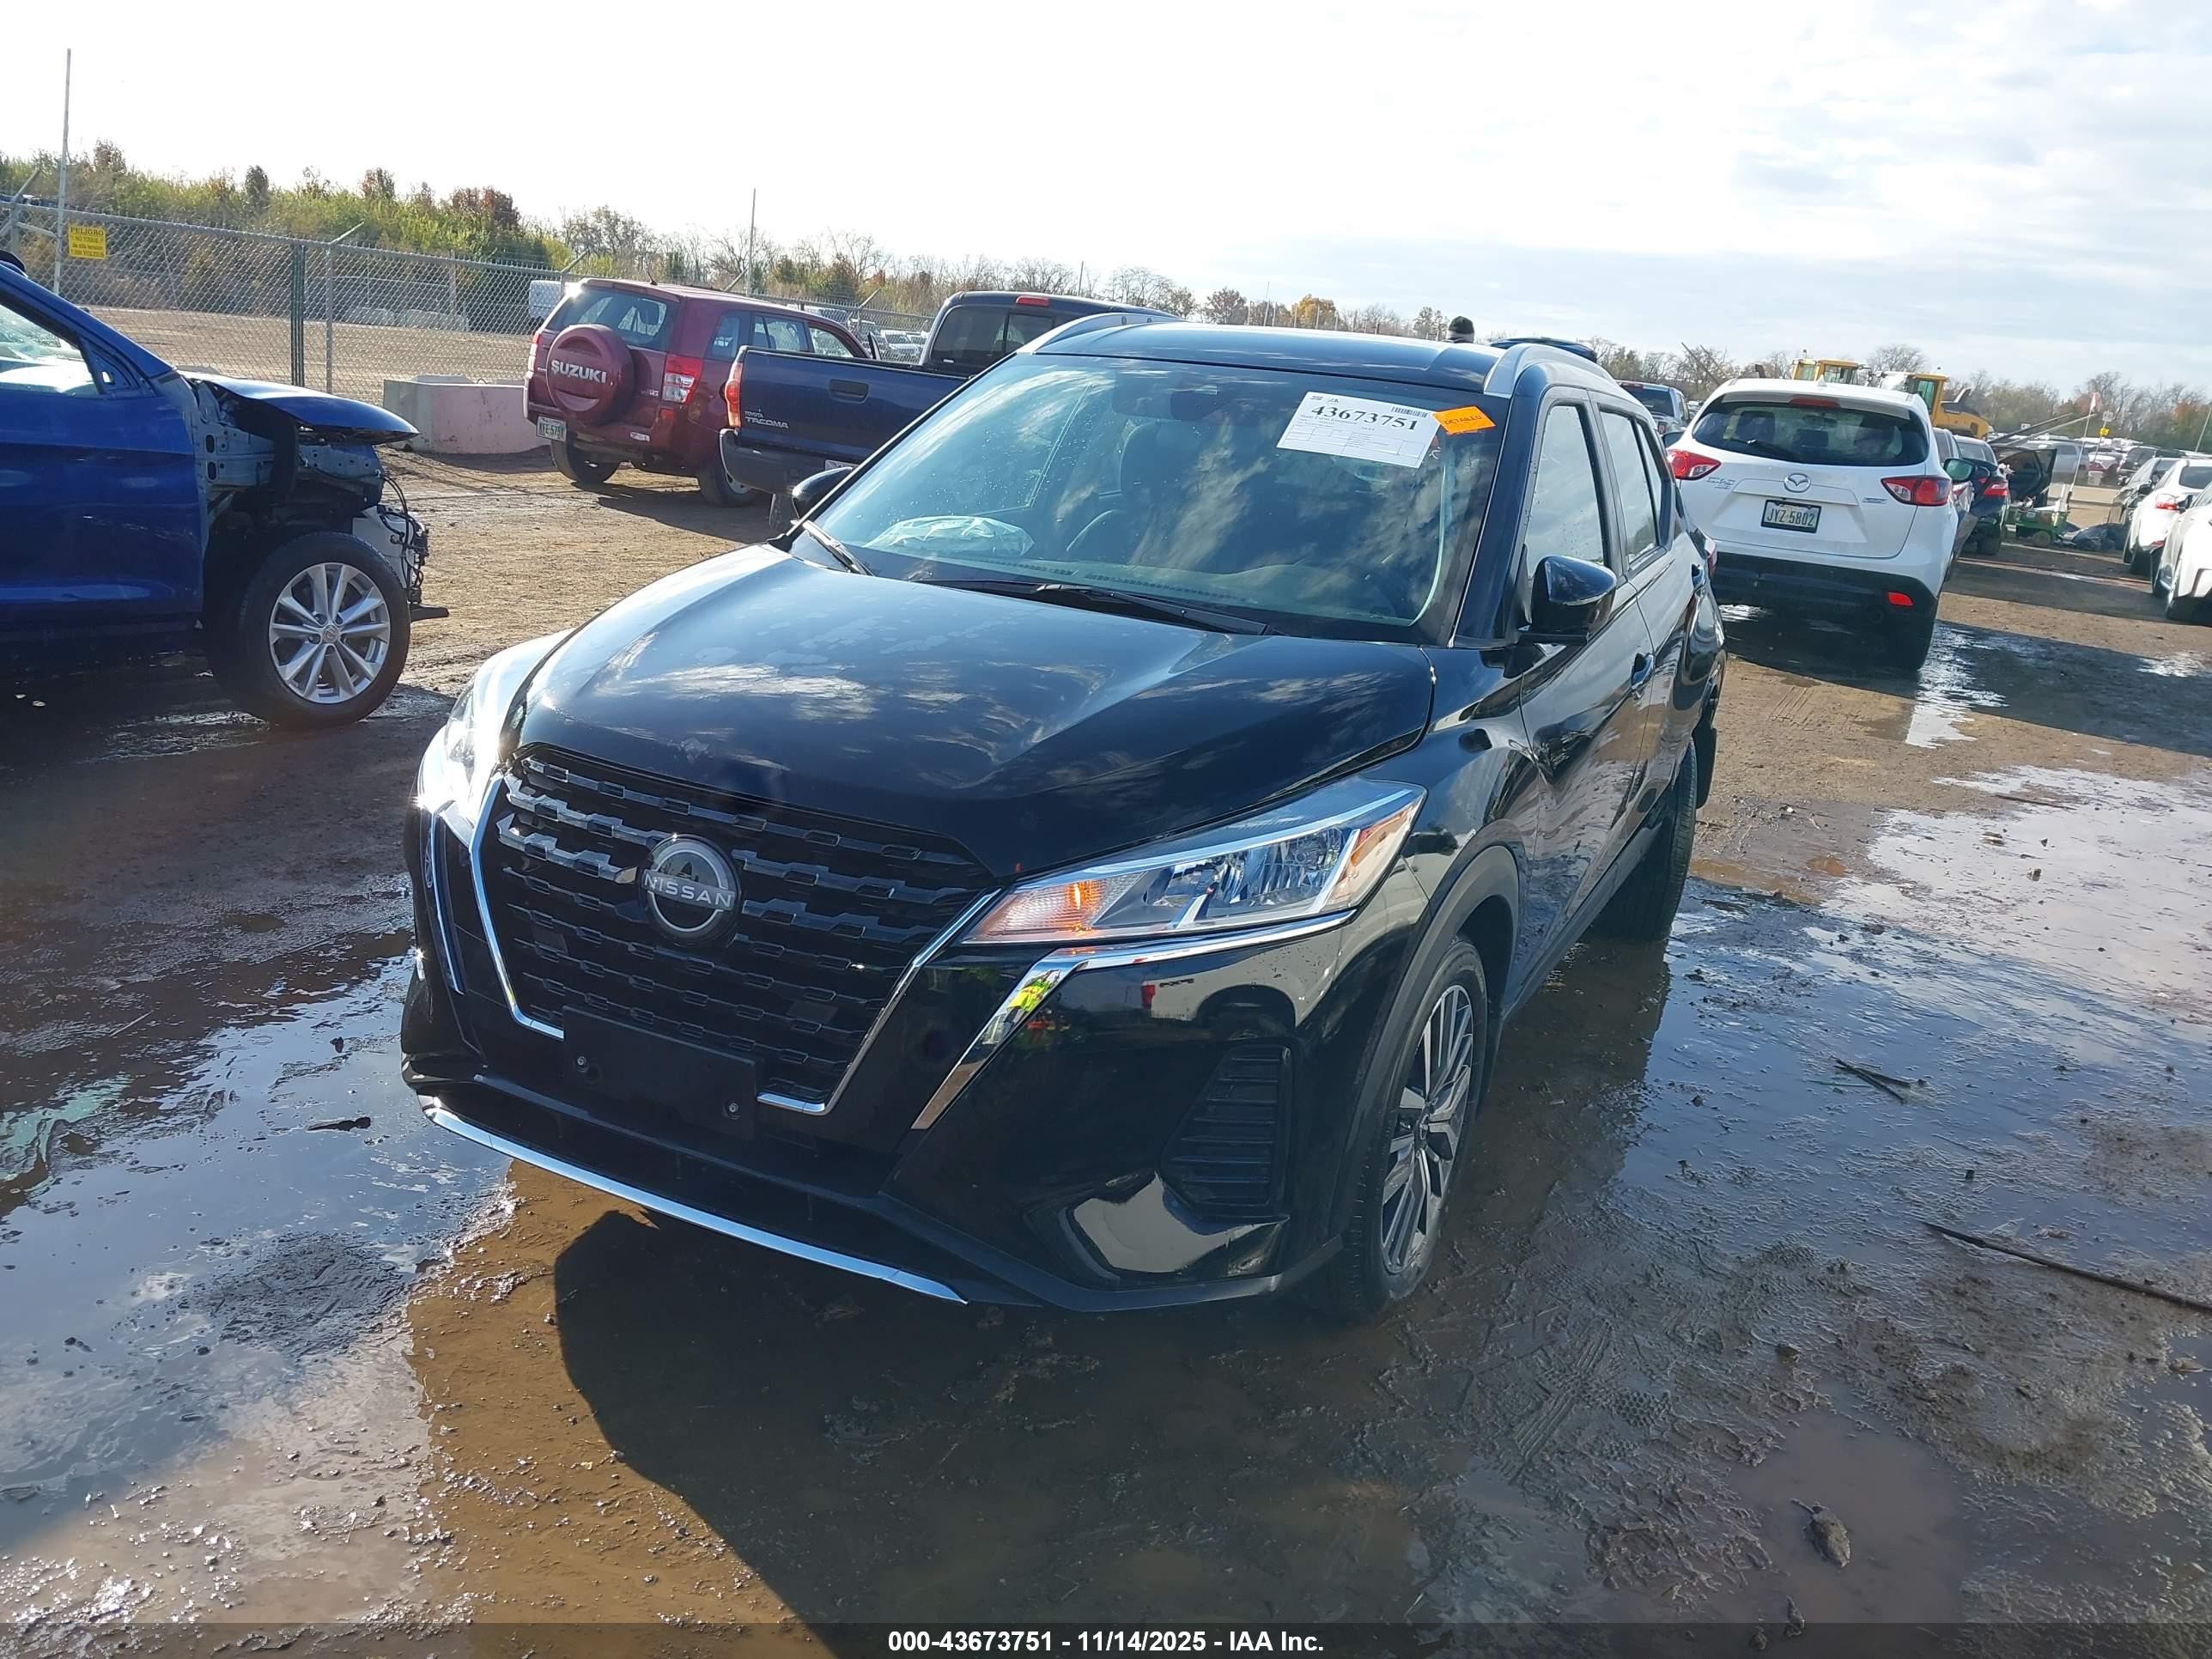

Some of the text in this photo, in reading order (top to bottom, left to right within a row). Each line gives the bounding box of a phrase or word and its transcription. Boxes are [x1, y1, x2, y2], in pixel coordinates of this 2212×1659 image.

[70, 227, 104, 235] PELIGRO
[551, 360, 607, 384] SUZUKI
[744, 416, 789, 429] TACOMA
[1311, 405, 1419, 430] 43673751
[1444, 415, 1482, 425] DETAILED
[1767, 508, 1814, 526] JYZ 5802
[644, 873, 732, 908] NISSAN
